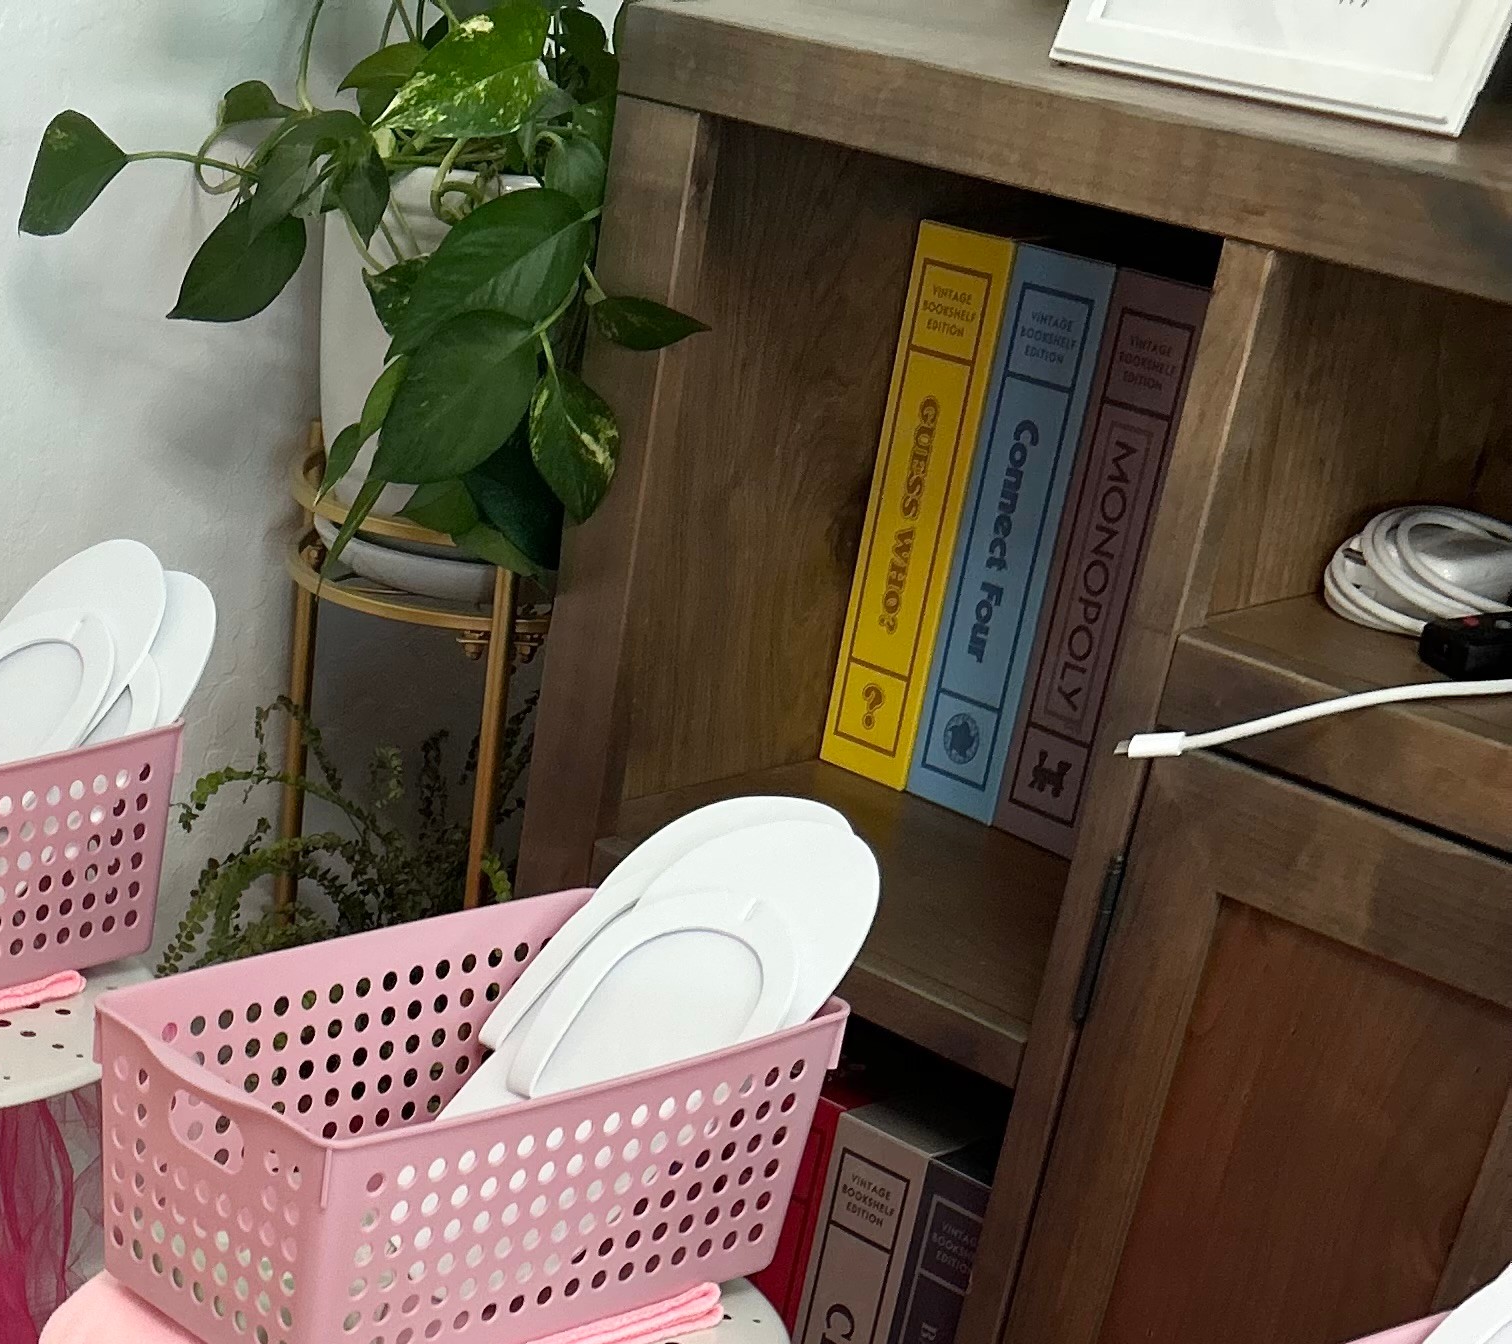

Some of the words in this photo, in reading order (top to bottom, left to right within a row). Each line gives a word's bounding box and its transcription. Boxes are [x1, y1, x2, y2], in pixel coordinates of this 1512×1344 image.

[932, 284, 973, 306] VINTAGE
[922, 300, 977, 323] BOOKSHELF
[1031, 311, 1075, 332] VINTAGE
[926, 318, 966, 338] EDITION
[1020, 326, 1078, 348] BOOKSHELF
[1024, 345, 1064, 365] EDITION
[1129, 336, 1173, 357] VINTAGE
[1119, 351, 1177, 376] BOOKSHELF
[1122, 370, 1163, 391] EDITION
[902, 395, 940, 521] GUESS
[986, 419, 1039, 571] Connect
[878, 526, 916, 634] WHO?
[1057, 439, 1138, 712] MONOPOLY
[967, 582, 1004, 663] Four
[851, 1174, 891, 1200] VINTAGE
[842, 1184, 895, 1217] BOOKSHELF
[846, 1202, 884, 1228] EDITION
